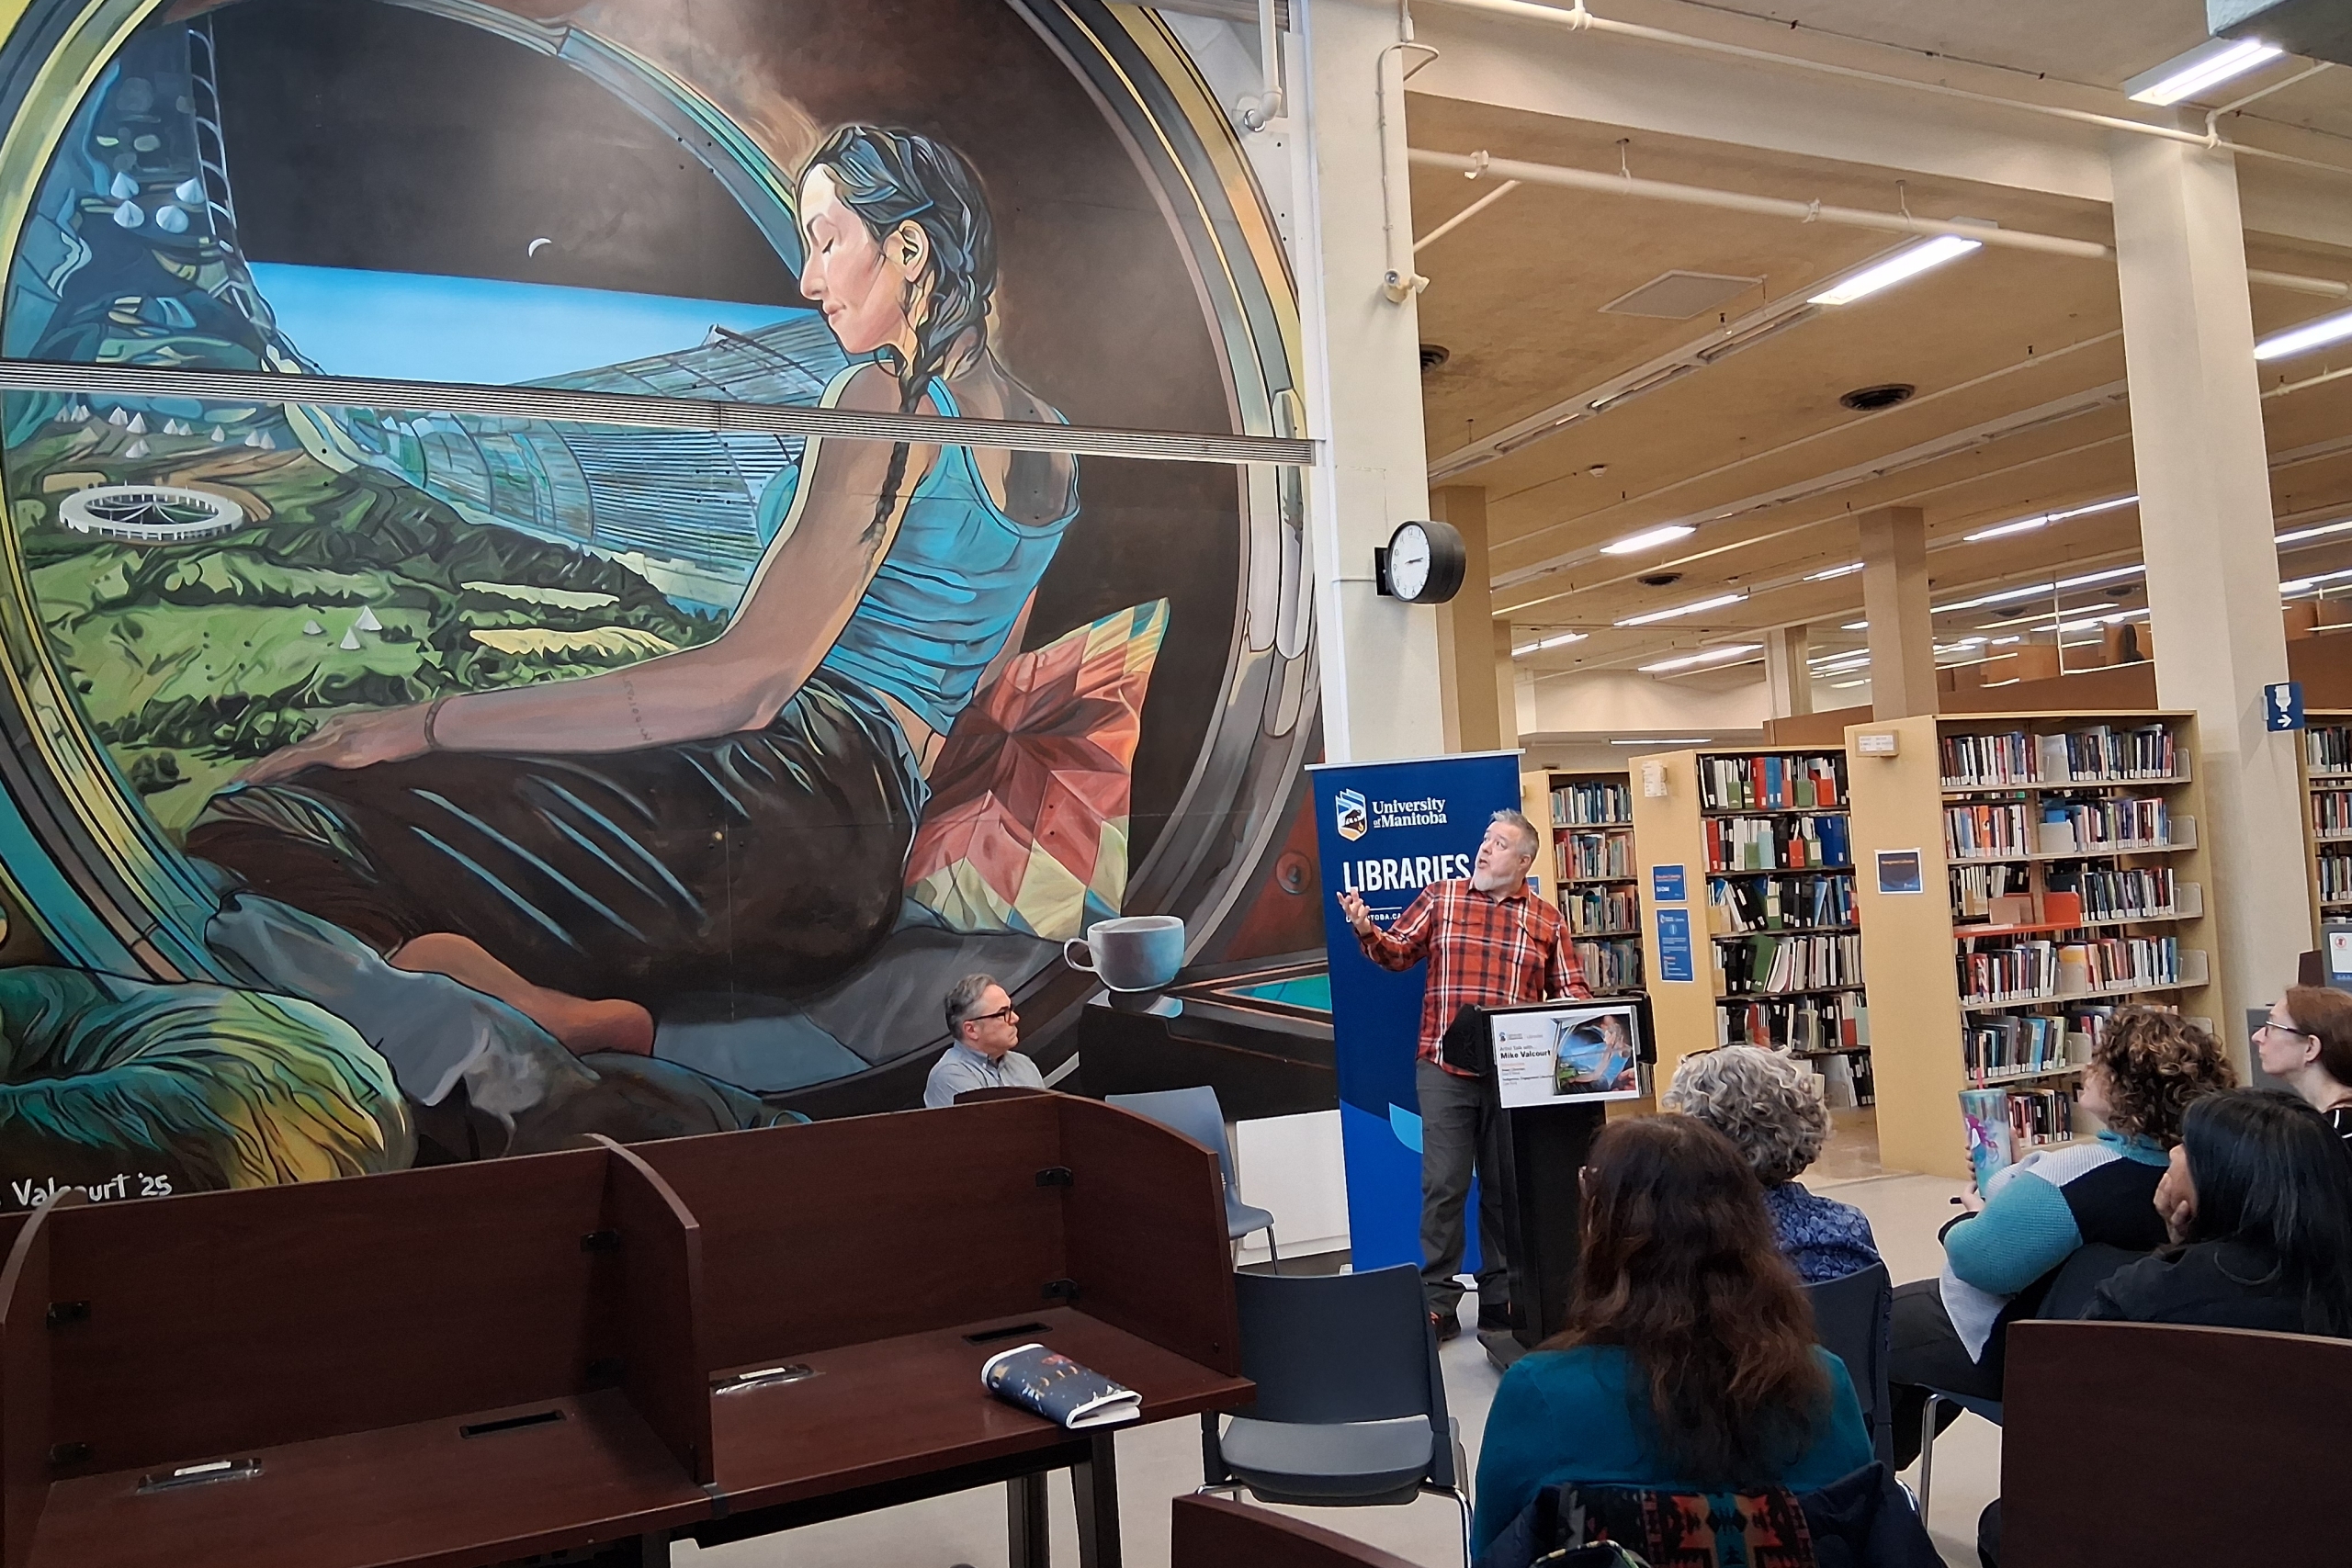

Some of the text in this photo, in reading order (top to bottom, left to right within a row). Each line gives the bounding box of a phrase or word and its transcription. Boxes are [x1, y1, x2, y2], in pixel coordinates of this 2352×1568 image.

[1372, 797, 1445, 814] University
[1374, 811, 1447, 828] of Manitoba
[1342, 854, 1471, 893] LIBRARIES
[1521, 1049, 1551, 1057] Valcourt
[11, 1172, 173, 1206] Valurt '25
